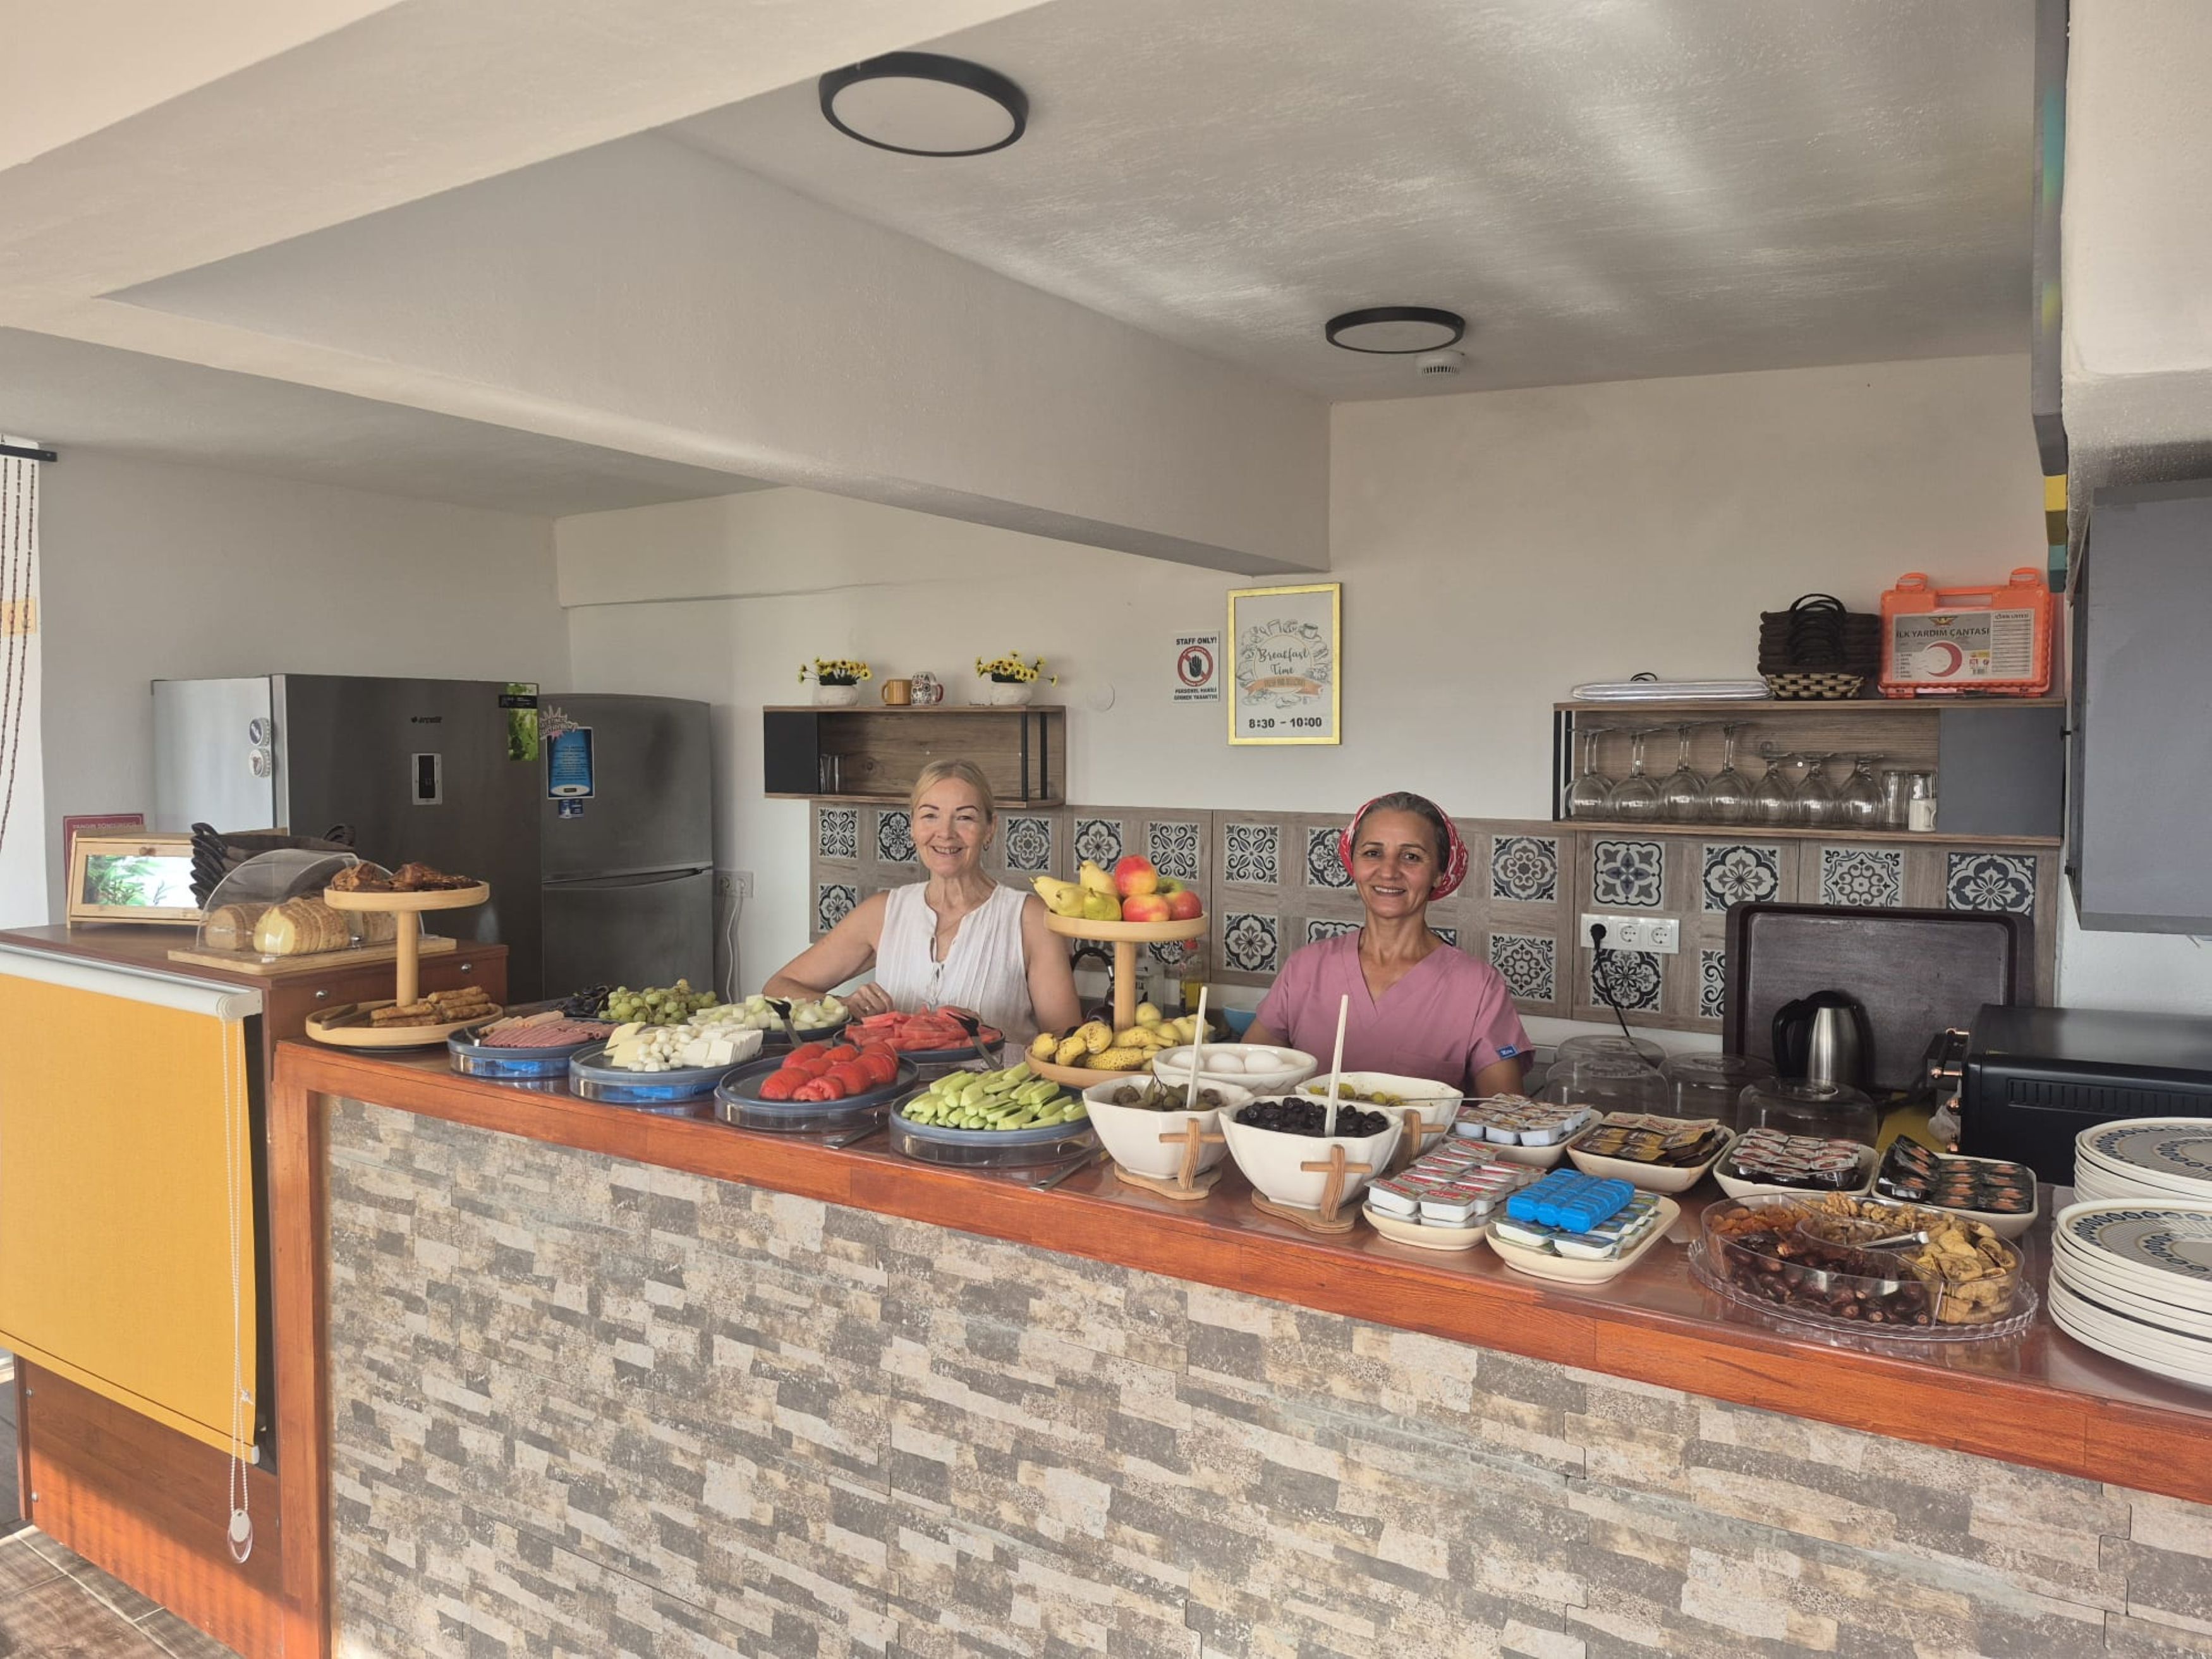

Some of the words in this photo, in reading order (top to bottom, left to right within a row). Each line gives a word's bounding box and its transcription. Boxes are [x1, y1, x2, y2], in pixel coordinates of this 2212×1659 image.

[1912, 628, 1948, 638] YARDIM
[1950, 627, 1990, 638] ÇANTASI
[1197, 636, 1217, 645] ONLY!
[1248, 718, 1275, 729] 8:30
[1290, 717, 1322, 727] 10:00
